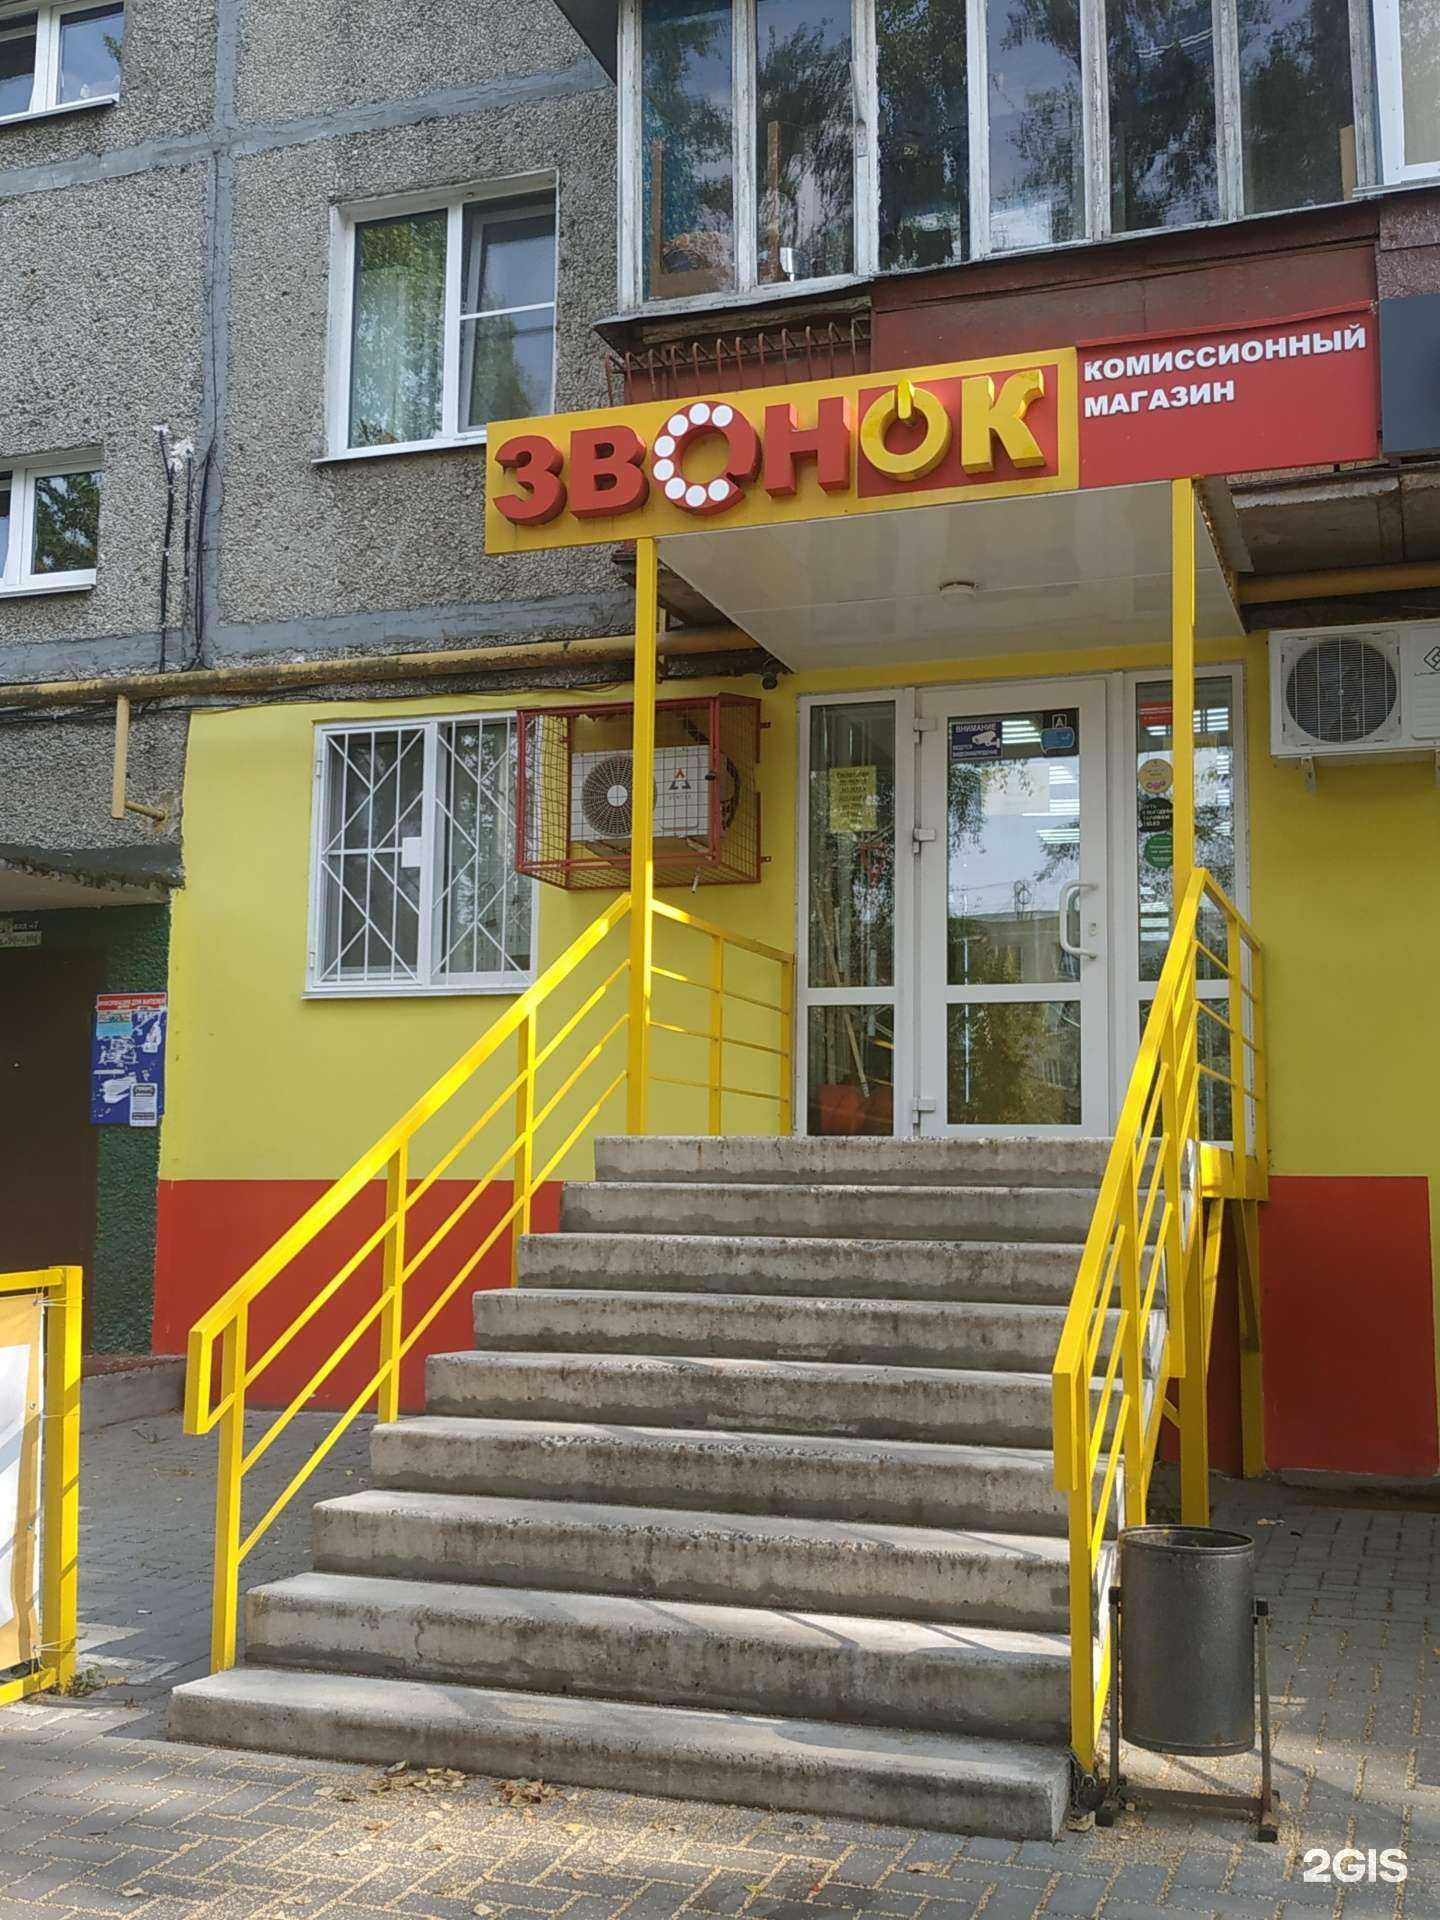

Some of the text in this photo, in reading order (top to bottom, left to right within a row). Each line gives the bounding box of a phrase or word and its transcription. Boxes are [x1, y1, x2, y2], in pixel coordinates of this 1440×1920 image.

[1084, 323, 1366, 382] КОМИССИОННЫЙ
[1084, 380, 1235, 419] МАГАЗИН
[493, 369, 1046, 526] ЗВОНОК
[955, 722, 997, 733] ВНИМАНИЕ
